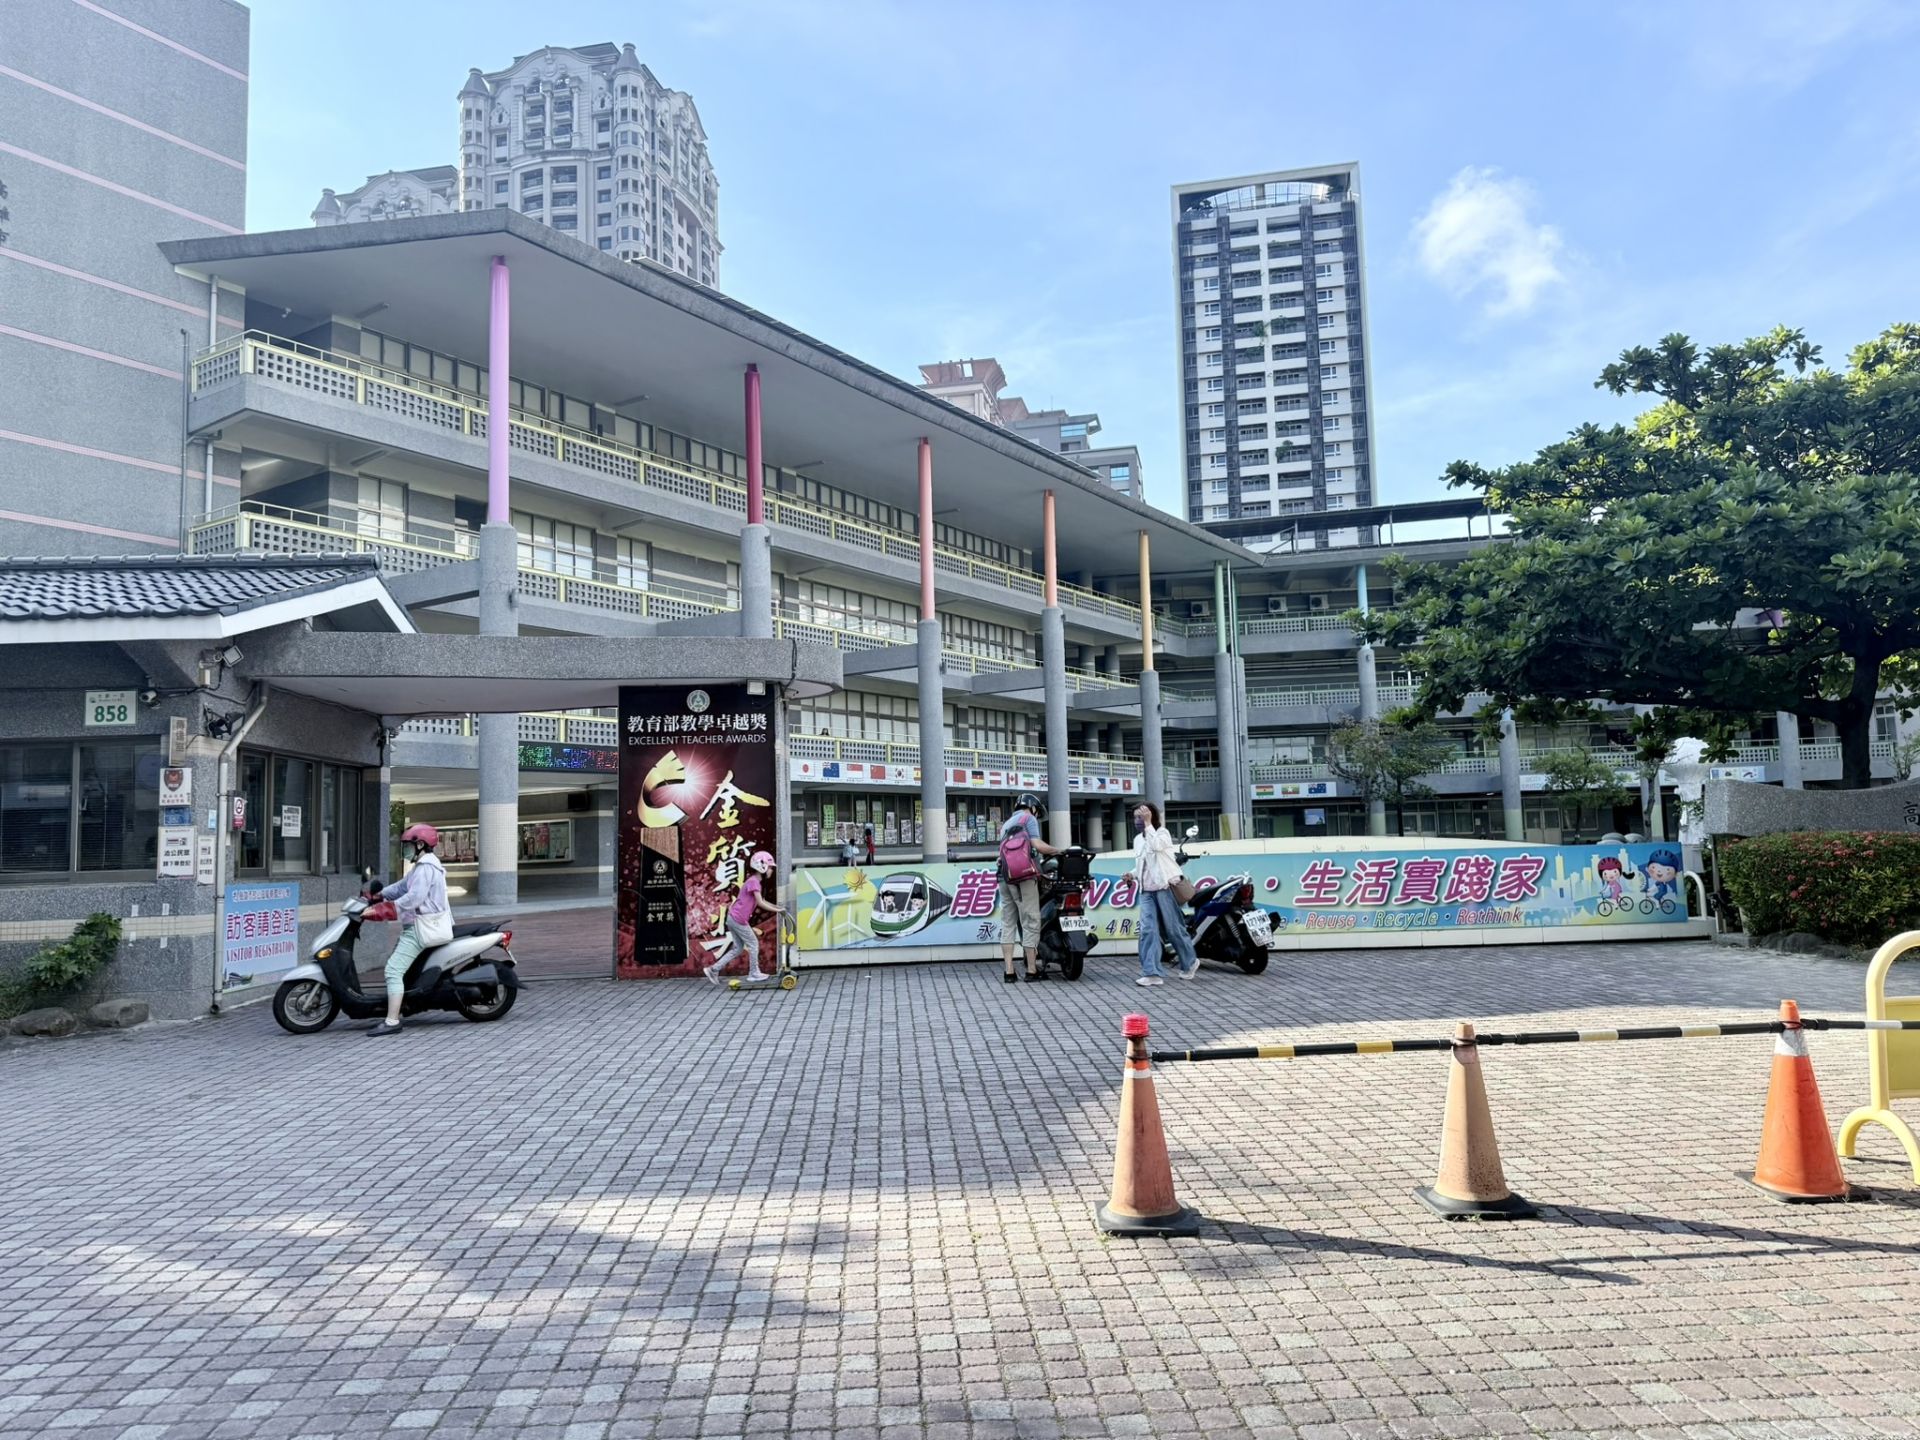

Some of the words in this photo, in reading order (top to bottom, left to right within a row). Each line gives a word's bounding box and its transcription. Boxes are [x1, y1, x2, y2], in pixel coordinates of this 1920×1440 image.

[94, 704, 127, 722] 858
[628, 736, 680, 745] EXCELLENT
[681, 735, 724, 744] TEACHER
[725, 733, 767, 743] AWARDS
[1294, 853, 1545, 904] 生活實踐家
[227, 908, 295, 940] 訪客請登記
[1305, 911, 1357, 929] Reuse
[1373, 907, 1438, 930] Recycle
[1456, 907, 1523, 925] Rethink
[227, 946, 252, 962] VISITOR
[255, 941, 295, 958] REGISTRATION
